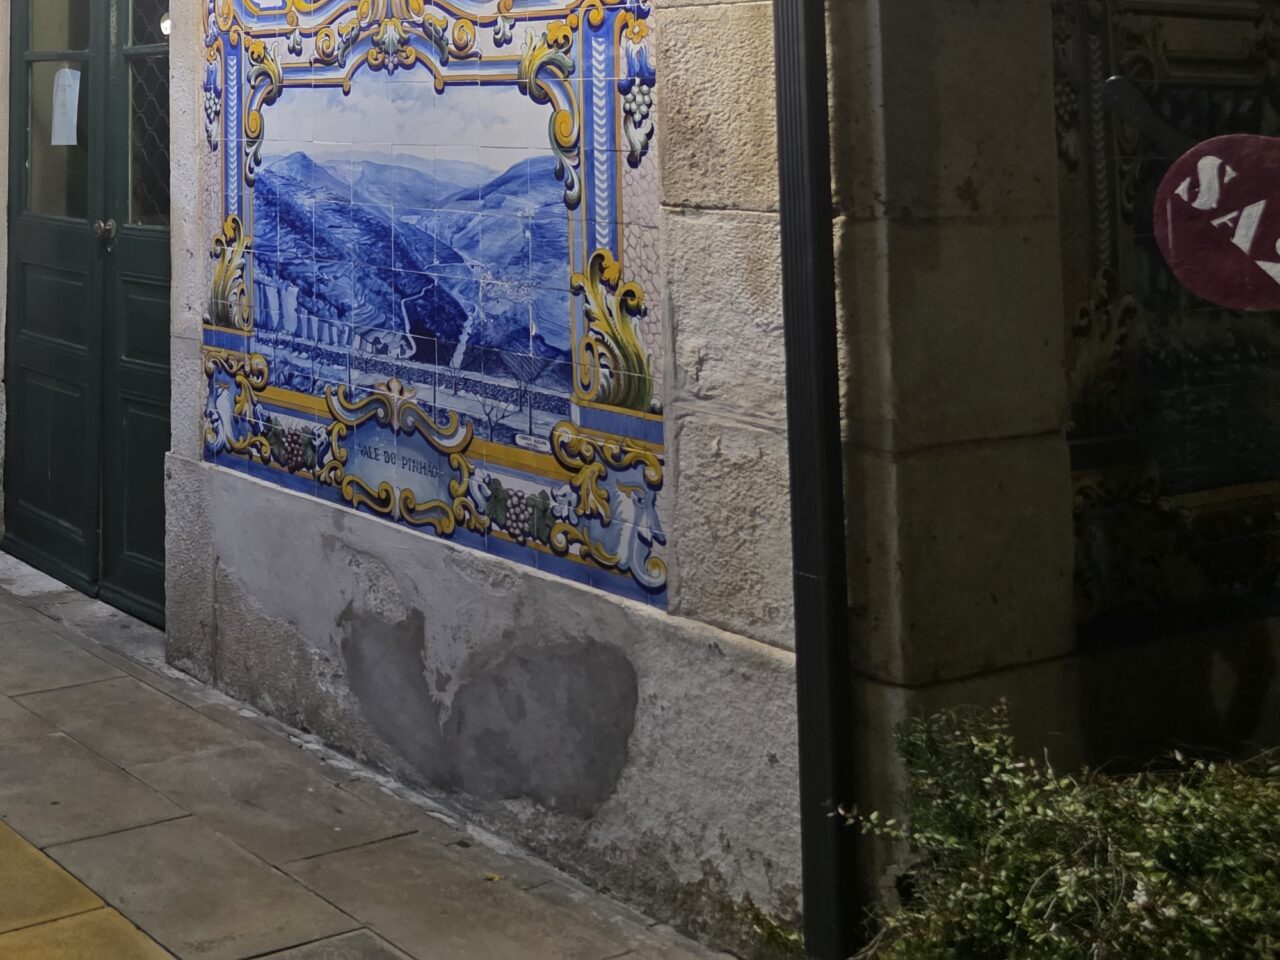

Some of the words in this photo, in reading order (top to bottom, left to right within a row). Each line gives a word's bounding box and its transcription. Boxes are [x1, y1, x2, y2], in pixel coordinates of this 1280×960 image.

[358, 443, 380, 462] VALE
[383, 451, 397, 465] DO
[401, 456, 439, 478] PINHÃO
